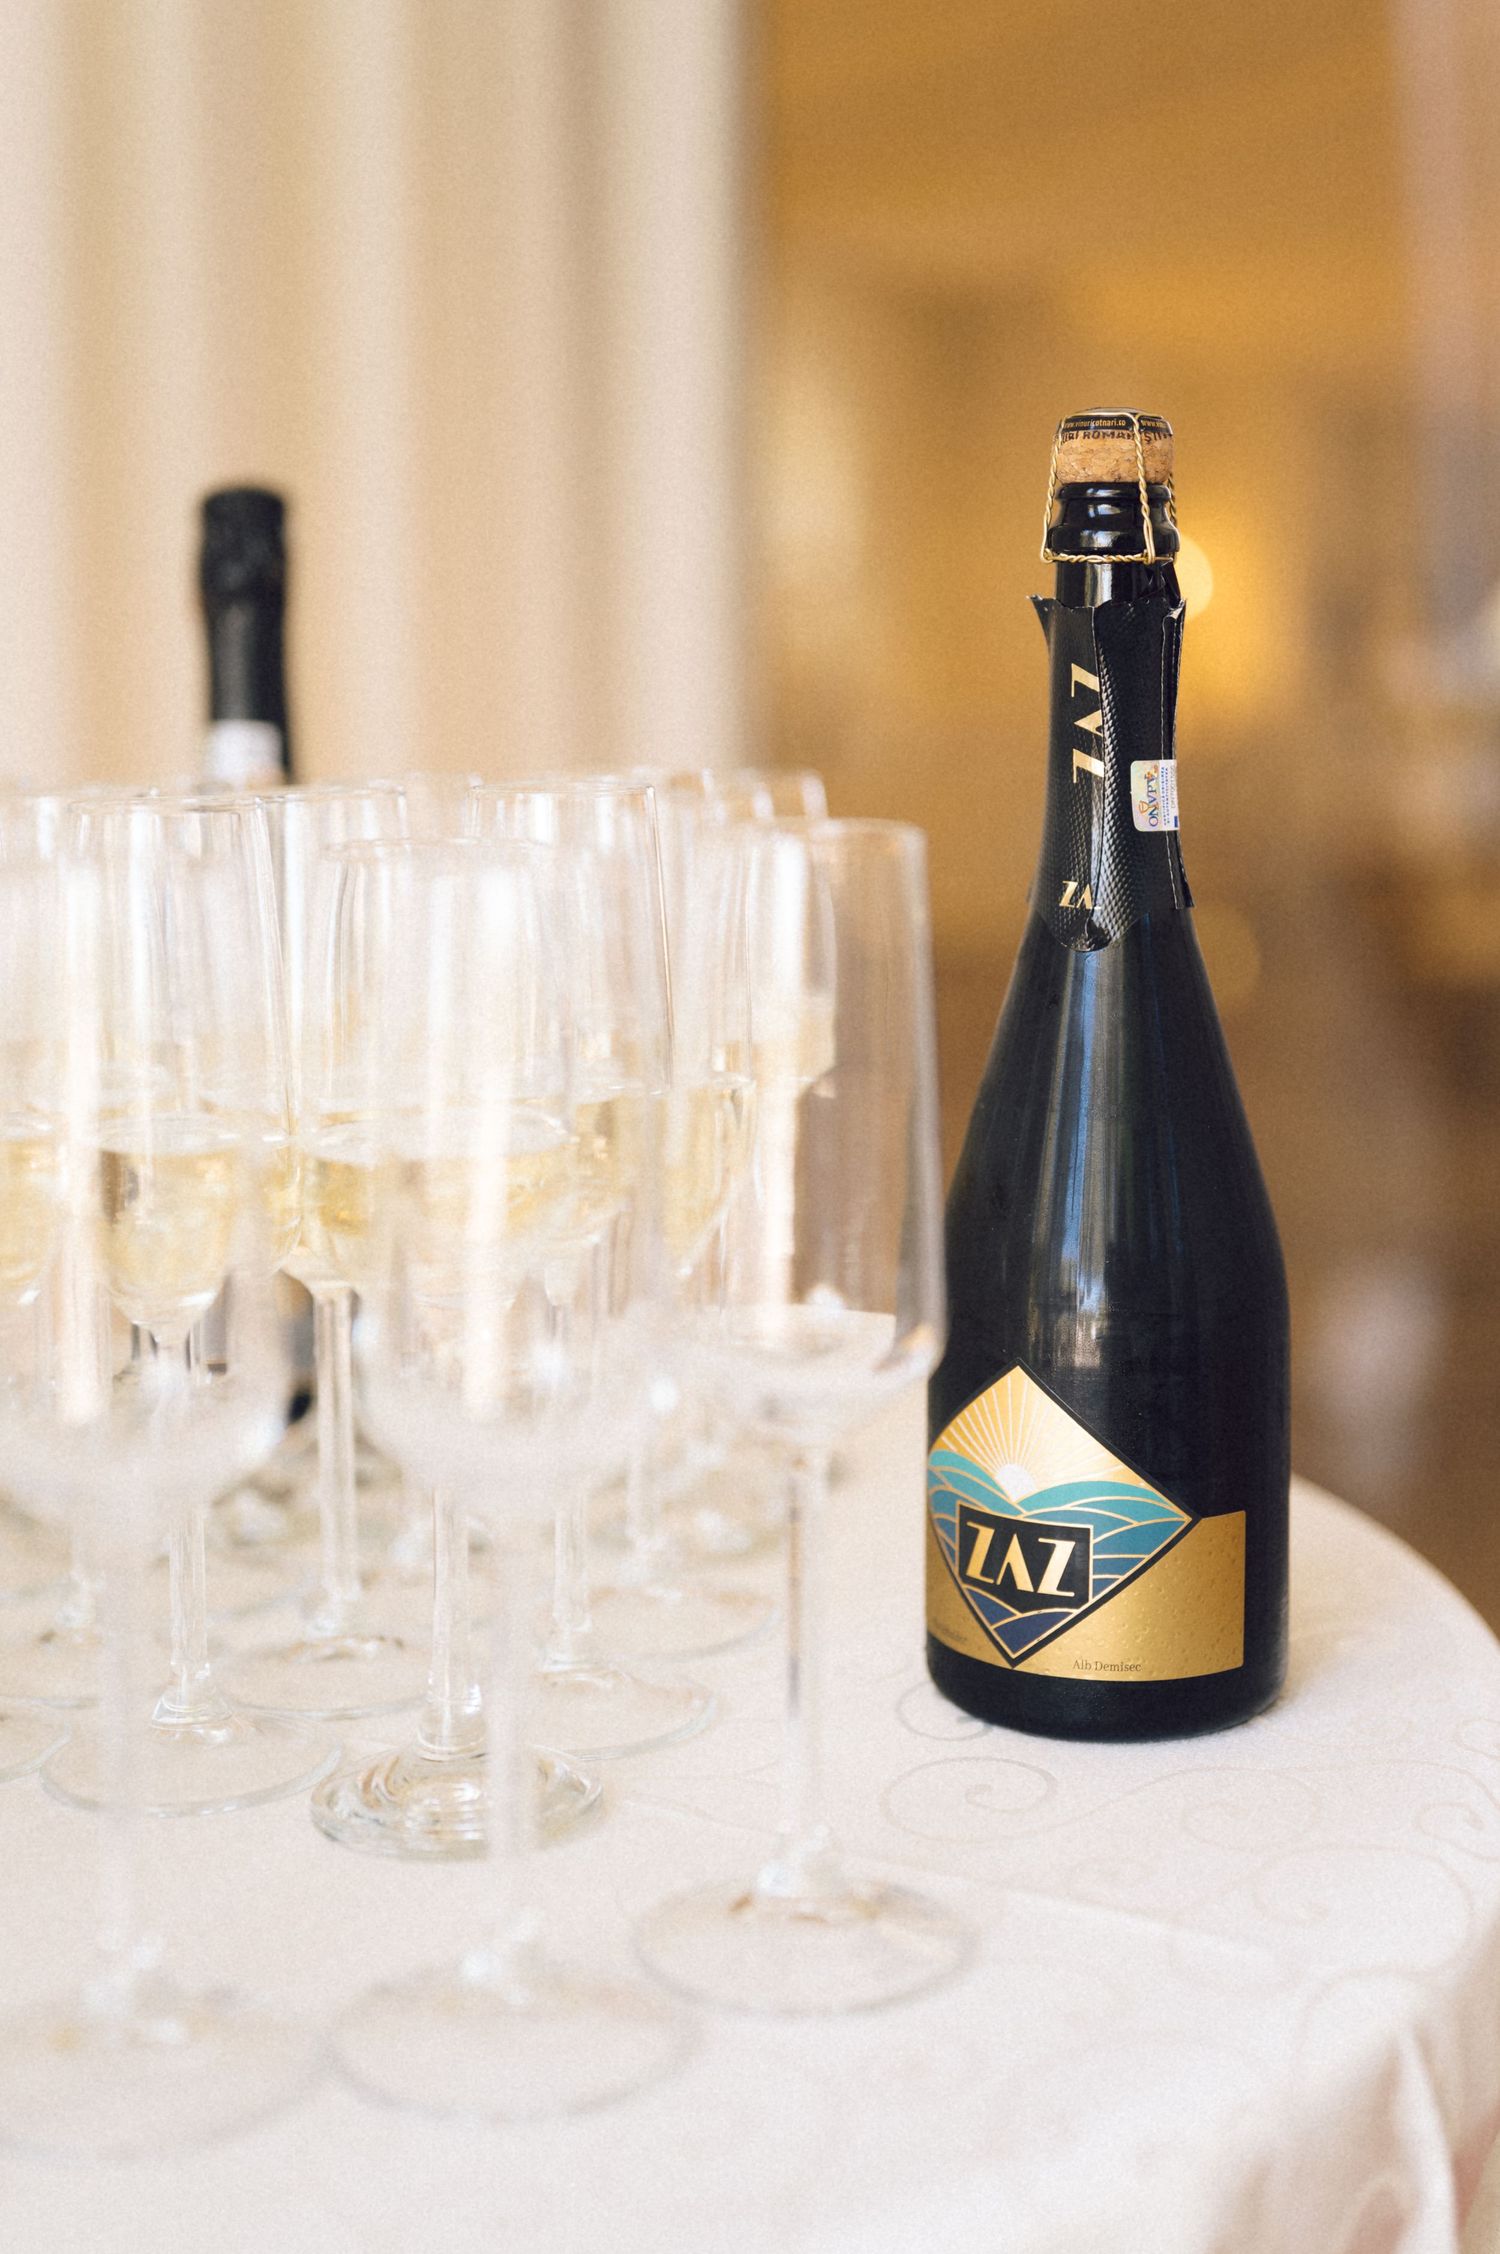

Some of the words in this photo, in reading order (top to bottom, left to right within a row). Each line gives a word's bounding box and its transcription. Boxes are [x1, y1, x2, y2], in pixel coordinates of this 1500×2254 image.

[1059, 880, 1101, 910] ZA
[965, 1520, 1076, 1597] ZAZ
[1072, 1659, 1092, 1671] Alb
[1094, 1660, 1143, 1672] Demisec
